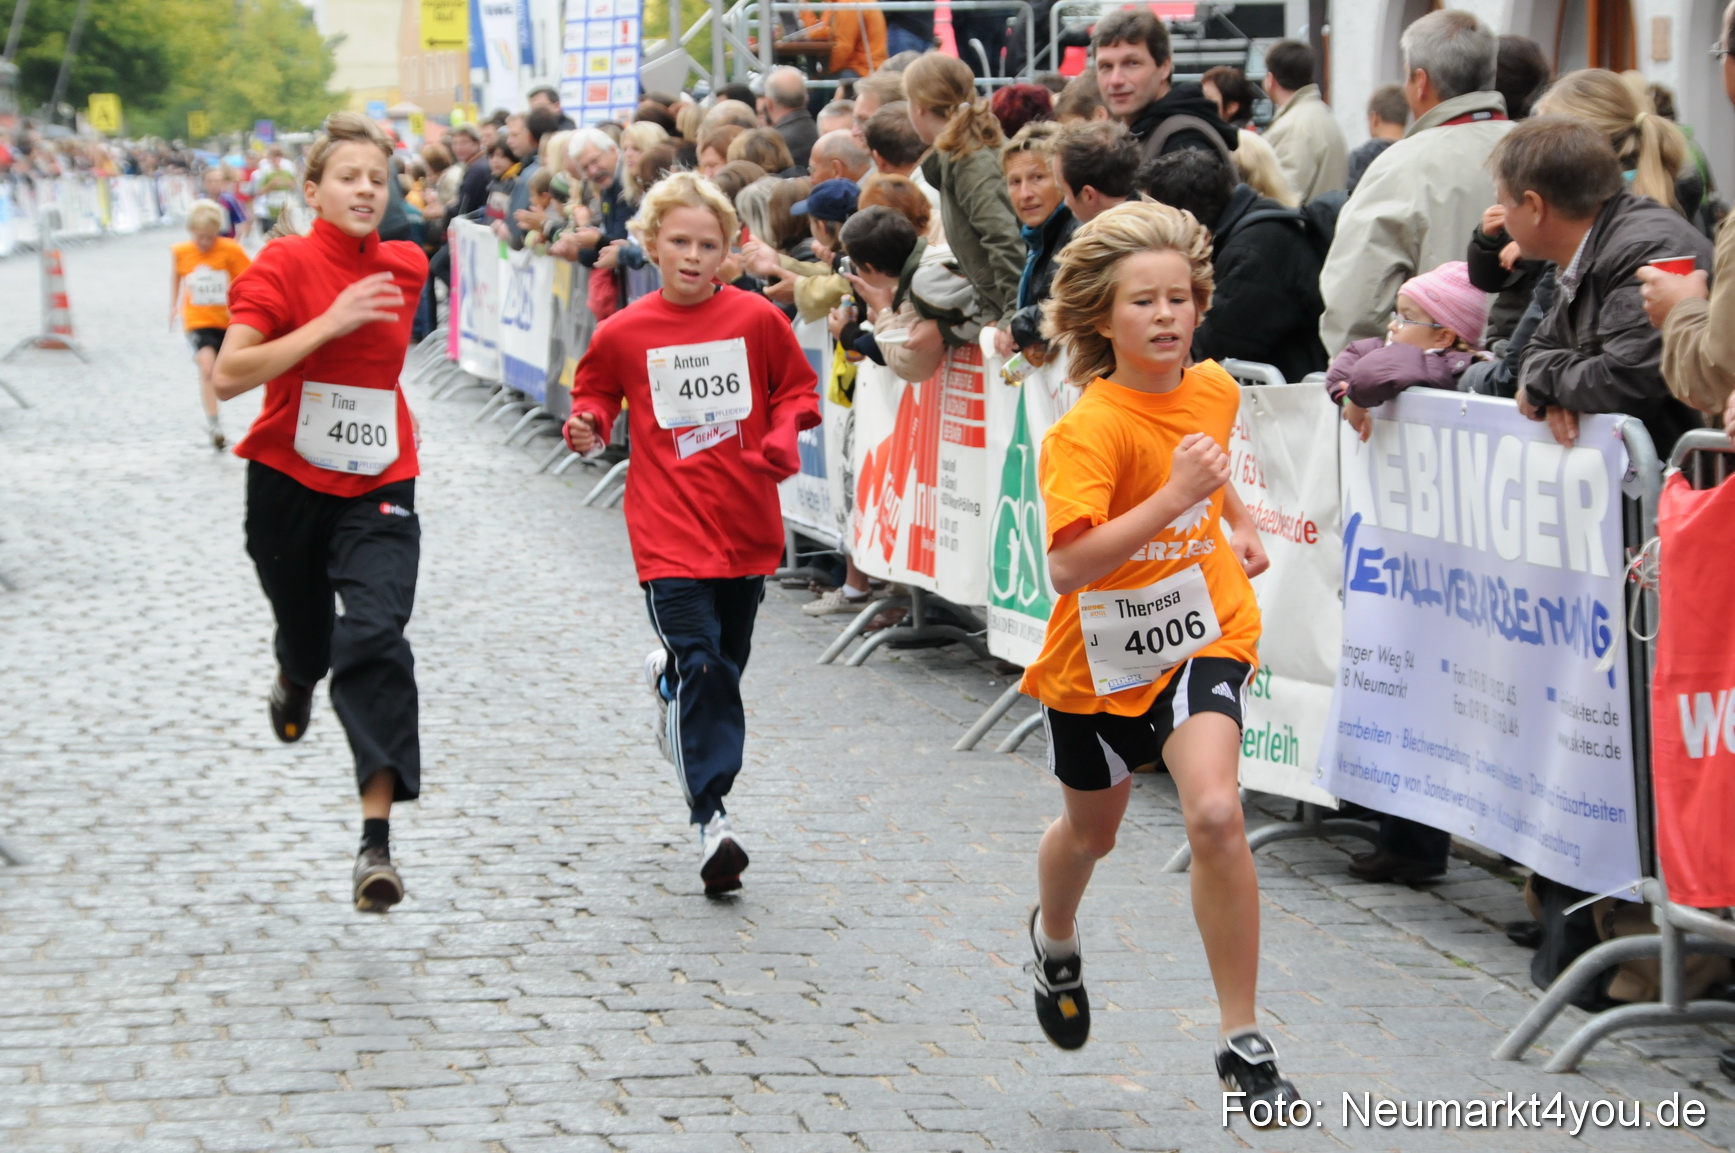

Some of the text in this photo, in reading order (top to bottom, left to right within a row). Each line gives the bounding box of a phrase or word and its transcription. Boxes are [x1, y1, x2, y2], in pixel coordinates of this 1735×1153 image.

[674, 354, 710, 370] Anton
[654, 380, 661, 392] J
[679, 372, 740, 400] 4036
[331, 392, 356, 411] Tina
[302, 414, 309, 426] J
[327, 420, 388, 447] 4080
[696, 426, 720, 444] DEHN
[1115, 590, 1181, 619] Theresa
[1090, 633, 1098, 647] J
[1124, 610, 1206, 656] 4006
[1378, 645, 1402, 673] Weg
[1353, 671, 1409, 699] Neumarkt
[1405, 777, 1422, 794] von
